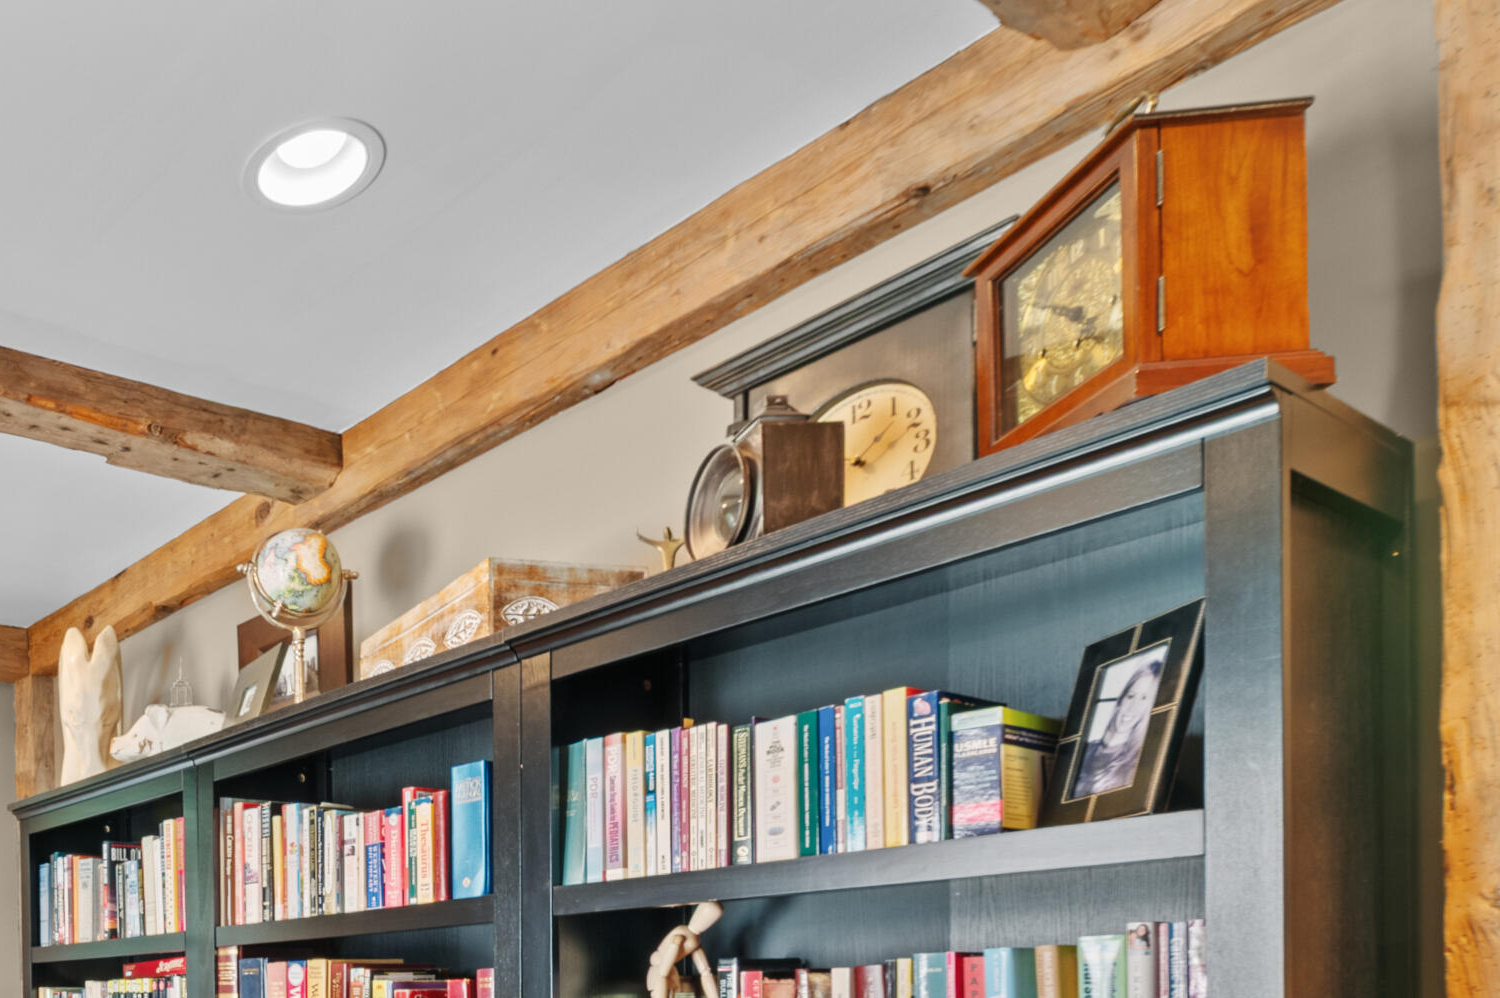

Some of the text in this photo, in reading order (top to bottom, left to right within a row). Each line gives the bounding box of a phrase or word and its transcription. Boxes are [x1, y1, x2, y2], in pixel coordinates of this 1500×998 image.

[852, 399, 872, 424] 12
[890, 397, 897, 416] 1
[908, 408, 922, 428] 2
[914, 429, 930, 453] 3
[901, 460, 920, 480] 4
[909, 713, 938, 826] HUMAN BODY
[590, 777, 599, 799] PDR
[420, 820, 429, 879] Thesaurus
[609, 822, 619, 863] PEDIATRICS
